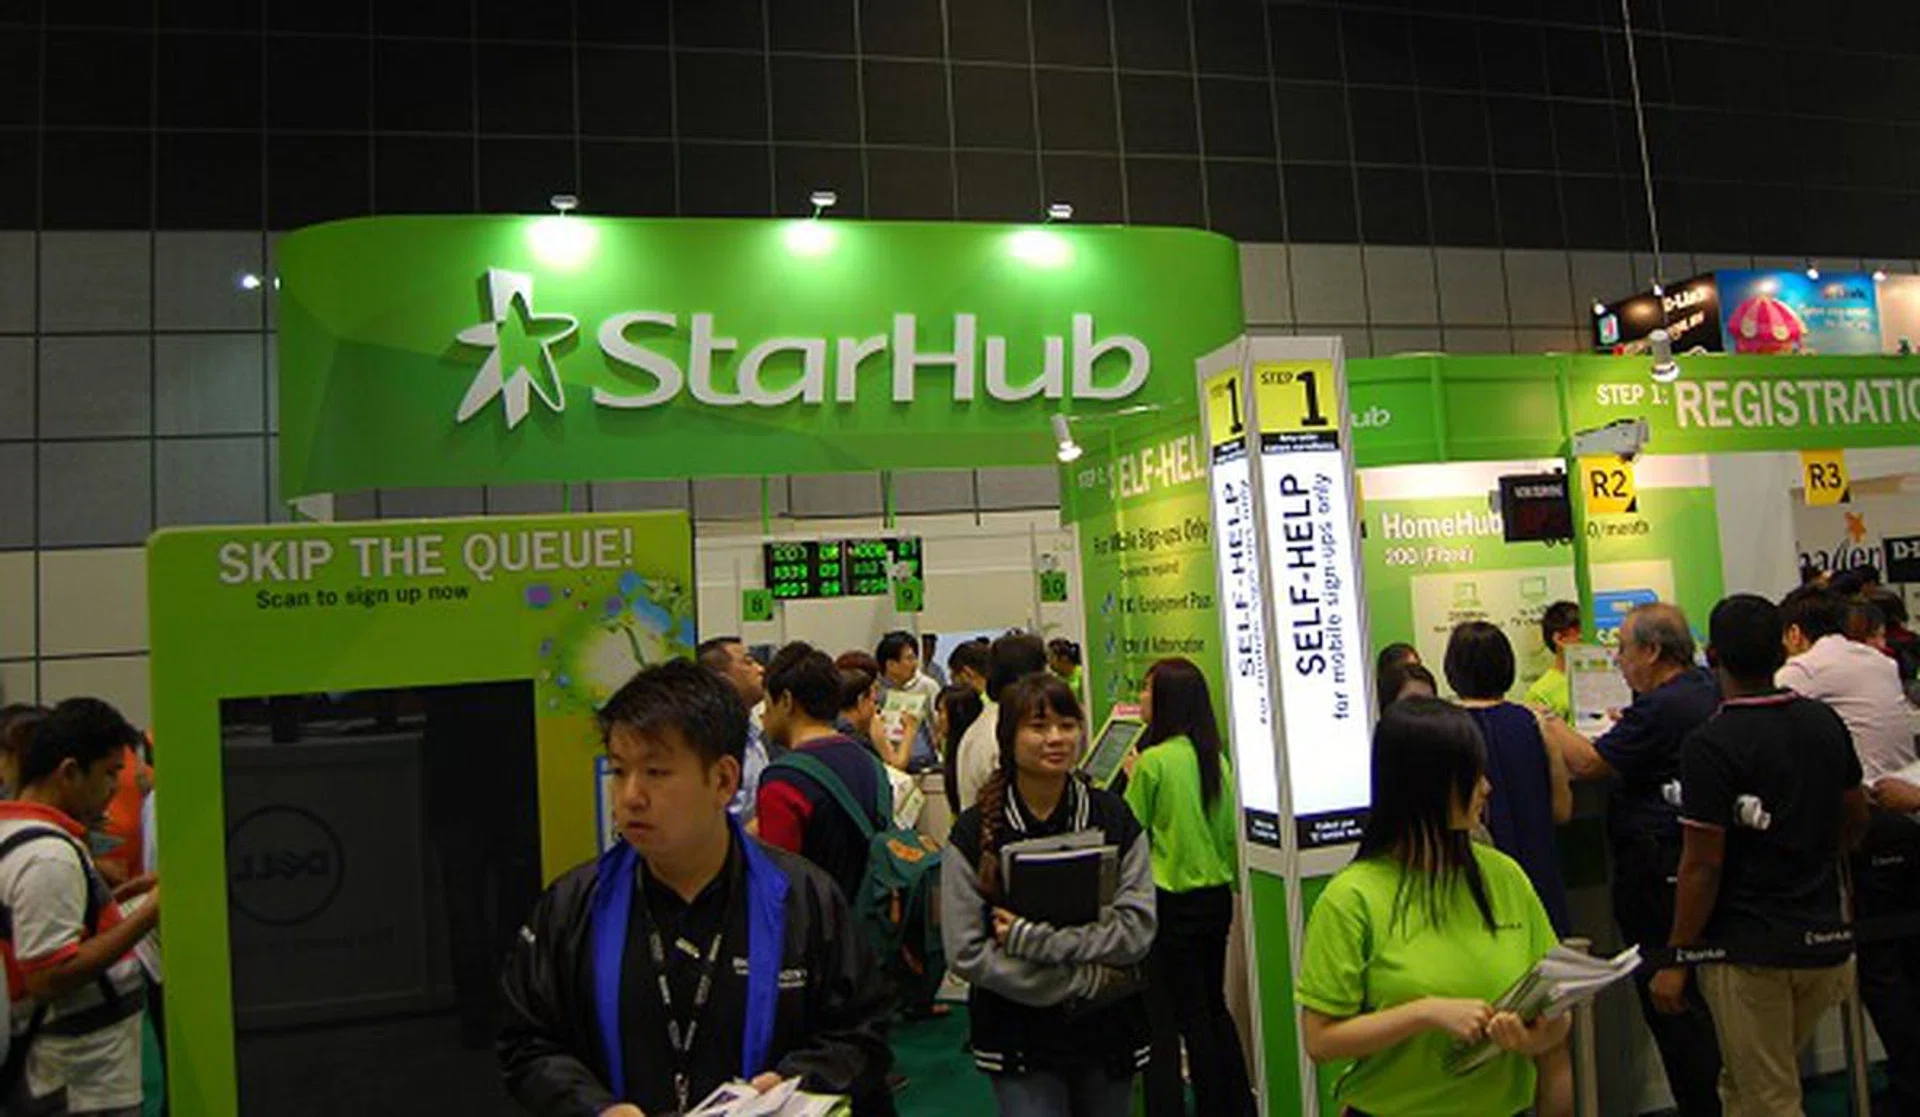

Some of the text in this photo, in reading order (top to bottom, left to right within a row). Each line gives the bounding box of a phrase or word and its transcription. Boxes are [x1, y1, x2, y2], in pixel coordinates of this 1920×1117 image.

[592, 311, 1152, 408] StarHub
[1226, 377, 1243, 434] 1
[1261, 370, 1328, 426] STEP 1
[1596, 384, 1645, 406] STEP
[1651, 384, 1668, 405] 1:
[1590, 470, 1627, 498] R2
[1808, 462, 1842, 489] R3
[1381, 509, 1504, 539] HomeHub
[218, 528, 635, 585] SKIP THE QUEUE!
[1223, 483, 1253, 676] SELF-HELP
[1280, 473, 1326, 676] SELF-HELP
[256, 585, 470, 609] Scan to sign up now
[1312, 473, 1349, 719] for mobile sign-ups only
